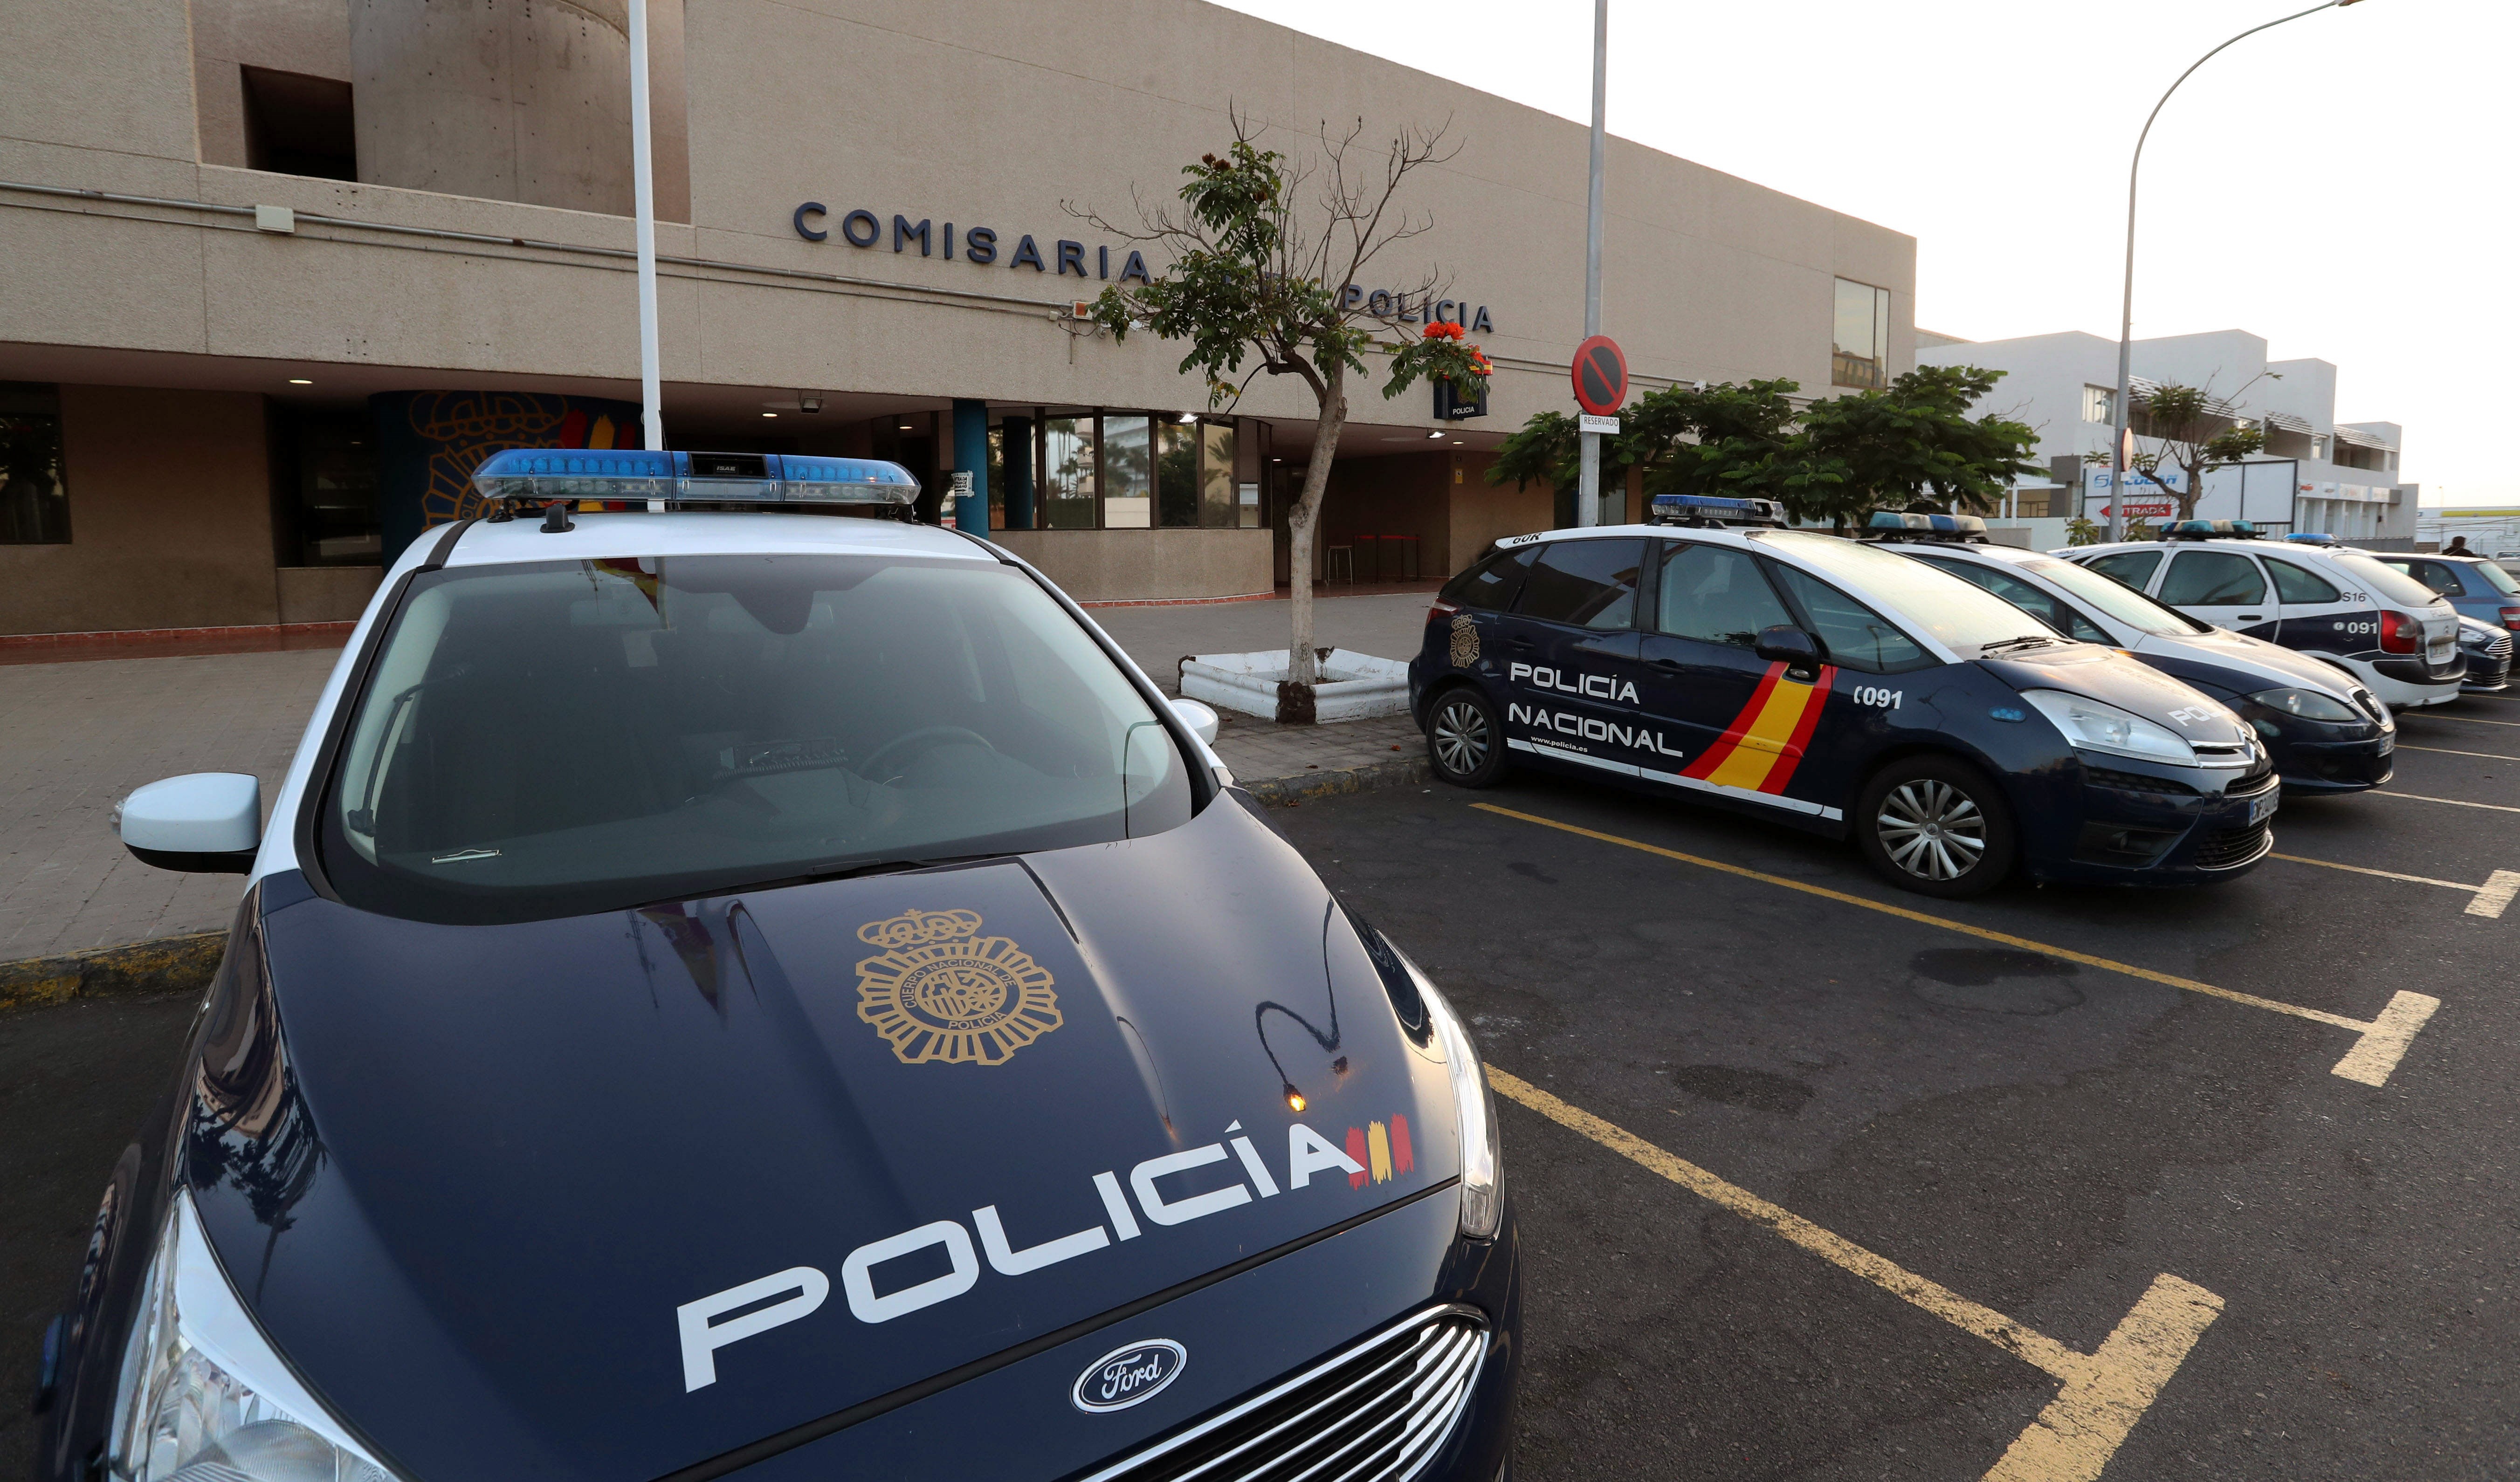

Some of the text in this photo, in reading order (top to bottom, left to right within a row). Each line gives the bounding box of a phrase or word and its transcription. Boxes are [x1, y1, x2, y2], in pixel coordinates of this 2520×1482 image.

[793, 201, 1151, 285] COMISARIA
[1343, 283, 1494, 333] POLICIA
[1453, 406, 1474, 415] POLICIA
[1584, 416, 1618, 426] RESERVADO
[2342, 592, 2366, 602] S16
[2348, 622, 2377, 634] 091
[1510, 662, 1640, 705] POLICÍA
[1863, 687, 1903, 709] 091
[1509, 703, 1683, 758] NACIONAL
[1531, 736, 1588, 752] www.policia.es
[902, 959, 1017, 1009] CUERPO NACIONAL DE
[948, 1011, 1007, 1030] POLICIA
[676, 1118, 1366, 1393] POLICÍA
[1101, 1353, 1163, 1400] Ford
